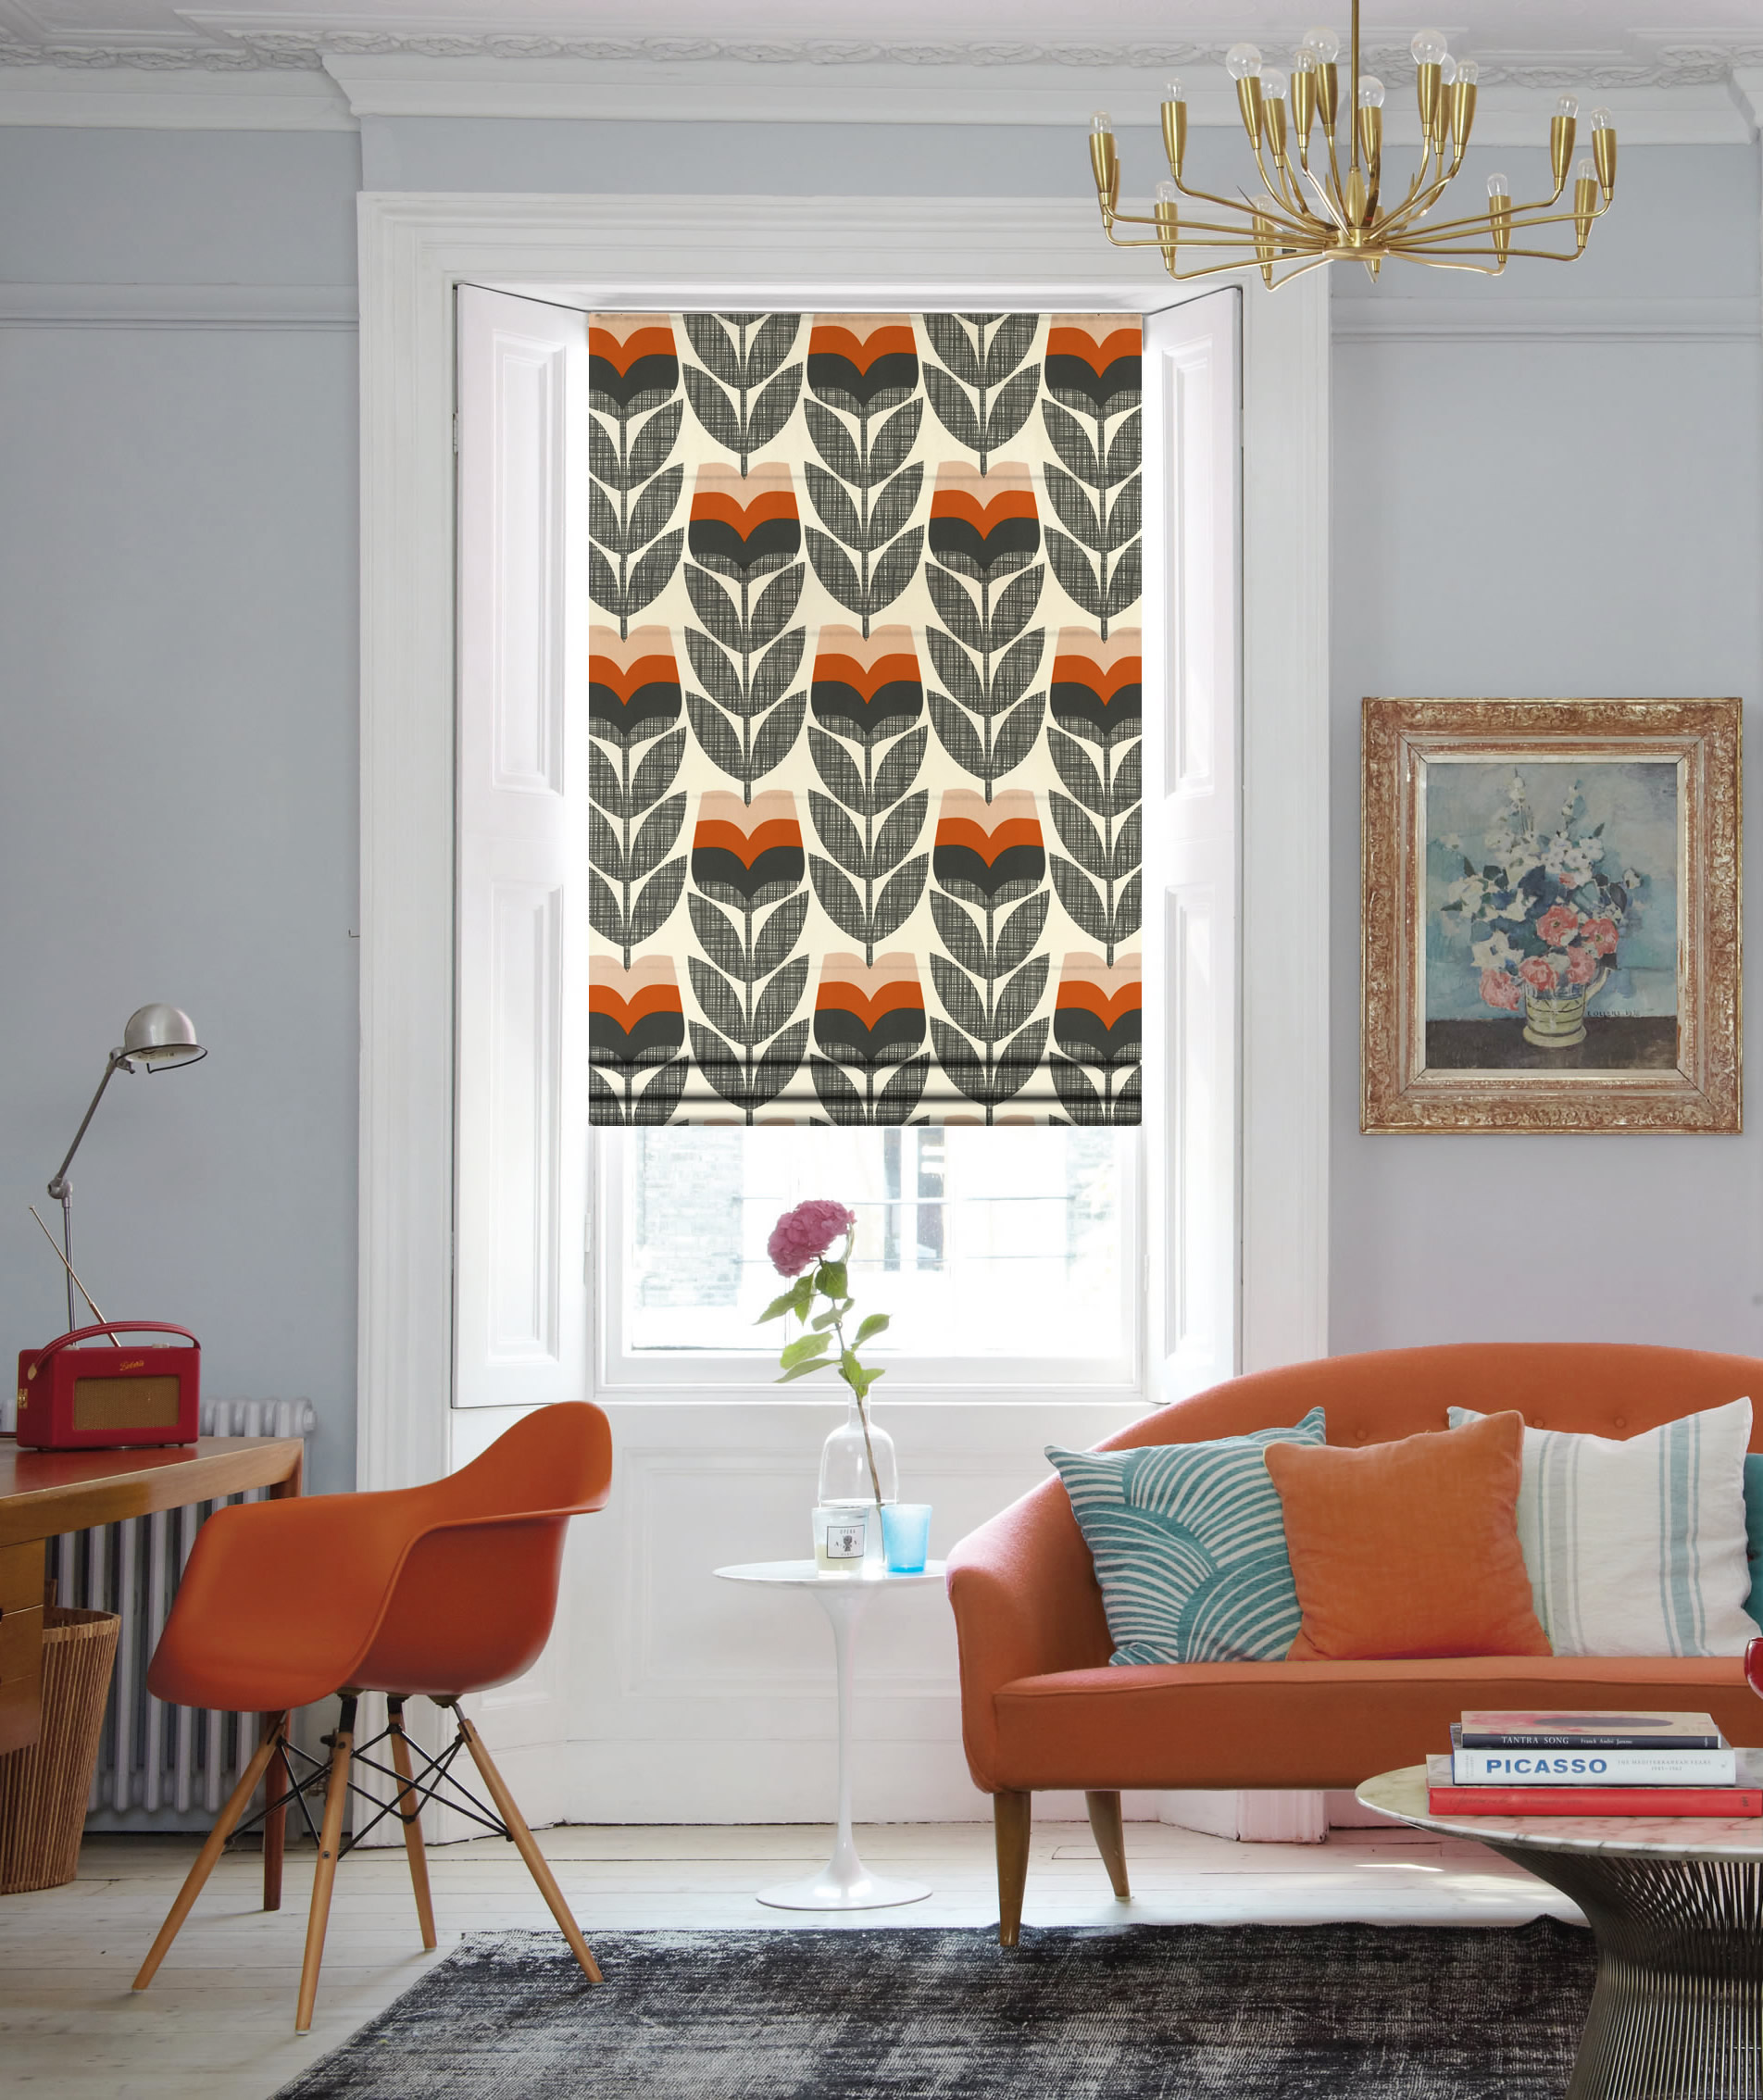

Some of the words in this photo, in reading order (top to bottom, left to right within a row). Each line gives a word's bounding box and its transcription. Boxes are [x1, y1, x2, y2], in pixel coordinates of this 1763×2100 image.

[1501, 1736, 1539, 1744] TANTRA
[1544, 1736, 1569, 1745] SONG
[1486, 1758, 1607, 1774] PICASSO
